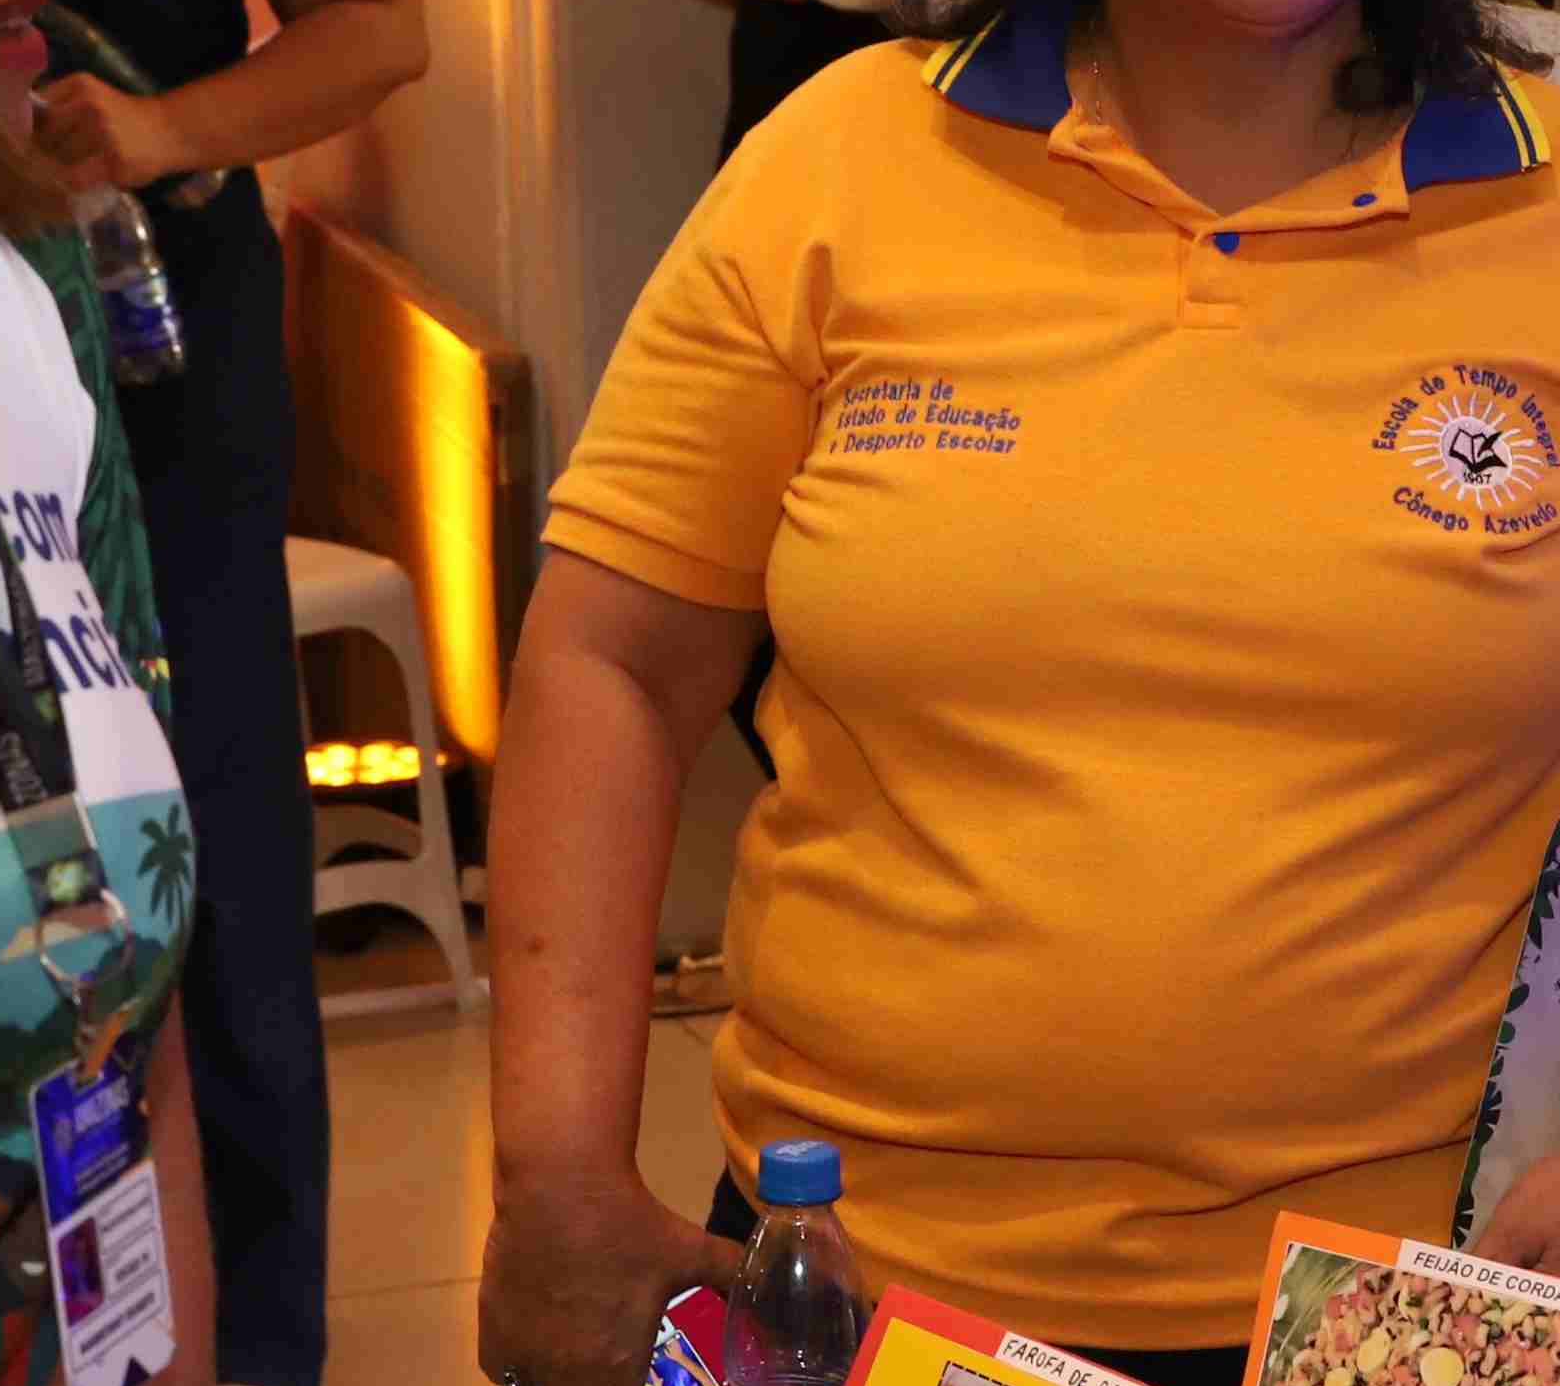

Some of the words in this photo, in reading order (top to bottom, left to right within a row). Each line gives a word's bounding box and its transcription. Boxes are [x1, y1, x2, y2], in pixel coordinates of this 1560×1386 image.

[930, 378, 953, 401] de
[1371, 396, 1419, 451] Escola
[1419, 375, 1445, 396] de
[1453, 364, 1518, 399] Tempo
[895, 404, 917, 425] de
[925, 403, 1021, 433] Educação
[936, 431, 1016, 454] Escolar
[1393, 486, 1469, 531] Cônego
[1484, 502, 1558, 534] Azevedo
[1413, 1250, 1474, 1280] FEIJÃO
[1476, 1266, 1503, 1287] DE
[1002, 1339, 1066, 1378] FAROFA
